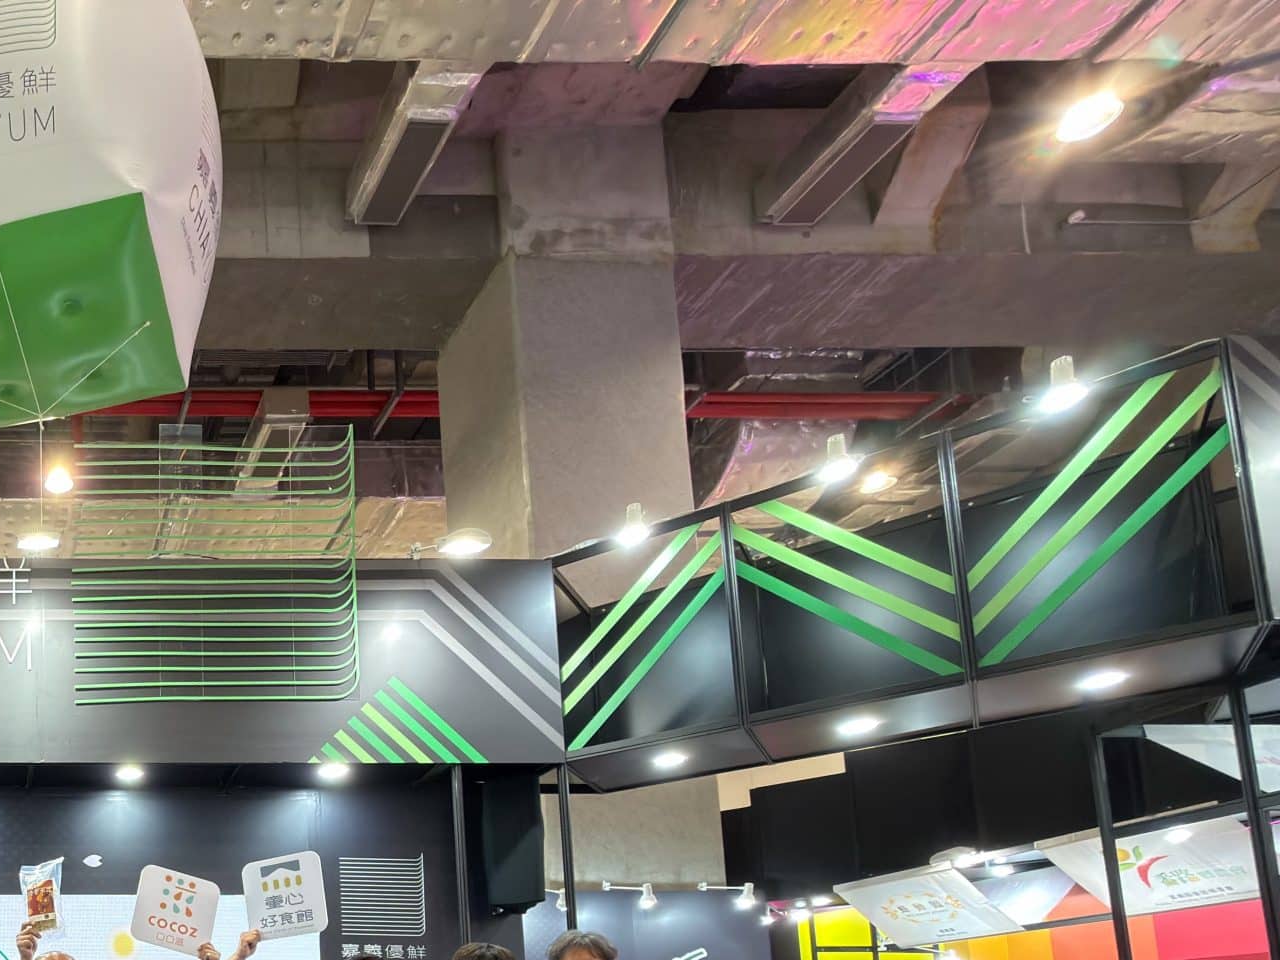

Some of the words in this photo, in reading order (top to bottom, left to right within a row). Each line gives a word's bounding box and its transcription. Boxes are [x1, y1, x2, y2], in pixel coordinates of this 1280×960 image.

[148, 915, 199, 938] COCOZ
[259, 909, 314, 929] 好食館
